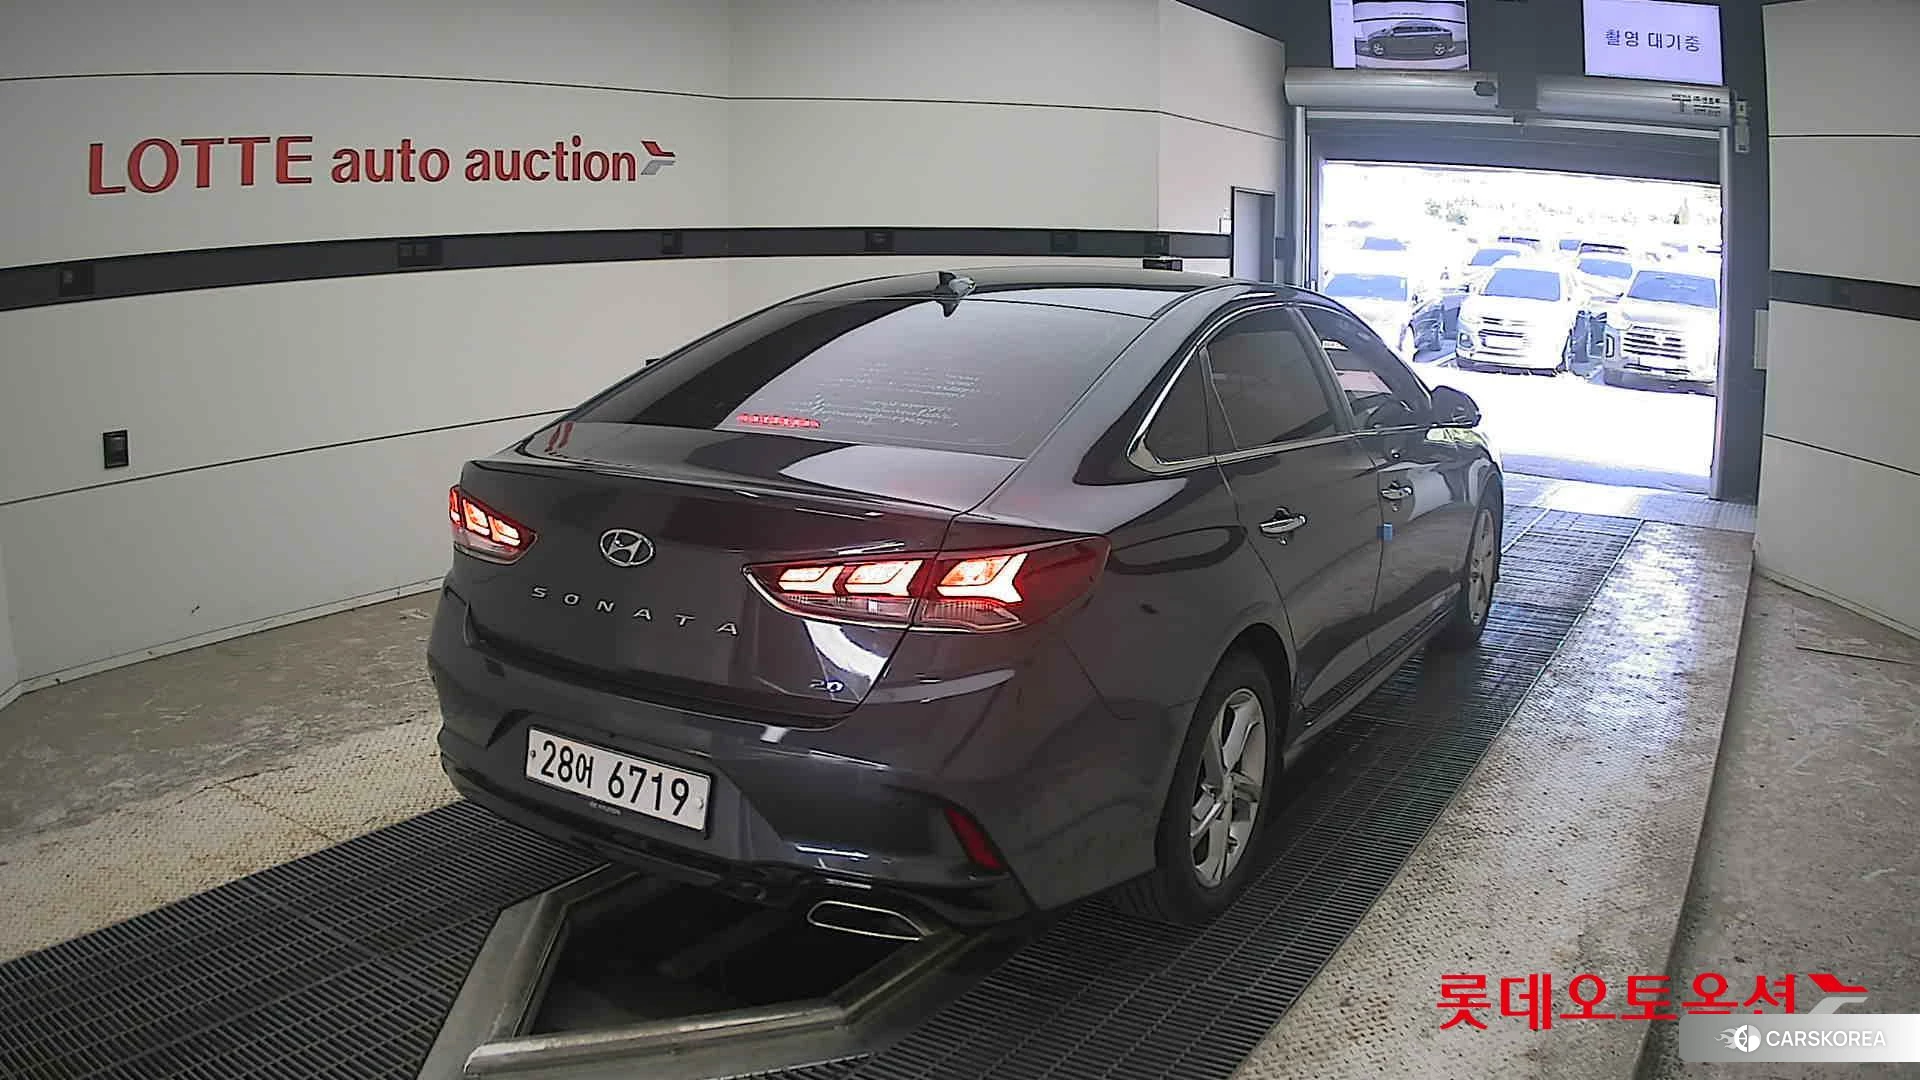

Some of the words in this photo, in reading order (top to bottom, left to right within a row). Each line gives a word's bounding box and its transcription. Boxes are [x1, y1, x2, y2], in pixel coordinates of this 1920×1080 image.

[1648, 33, 1701, 52] 대기중
[89, 136, 314, 194] LOTTE
[331, 138, 450, 183] auto
[465, 135, 637, 182] auction
[532, 587, 738, 635] SONATA
[541, 740, 594, 788] 28어
[608, 761, 690, 816] 6719
